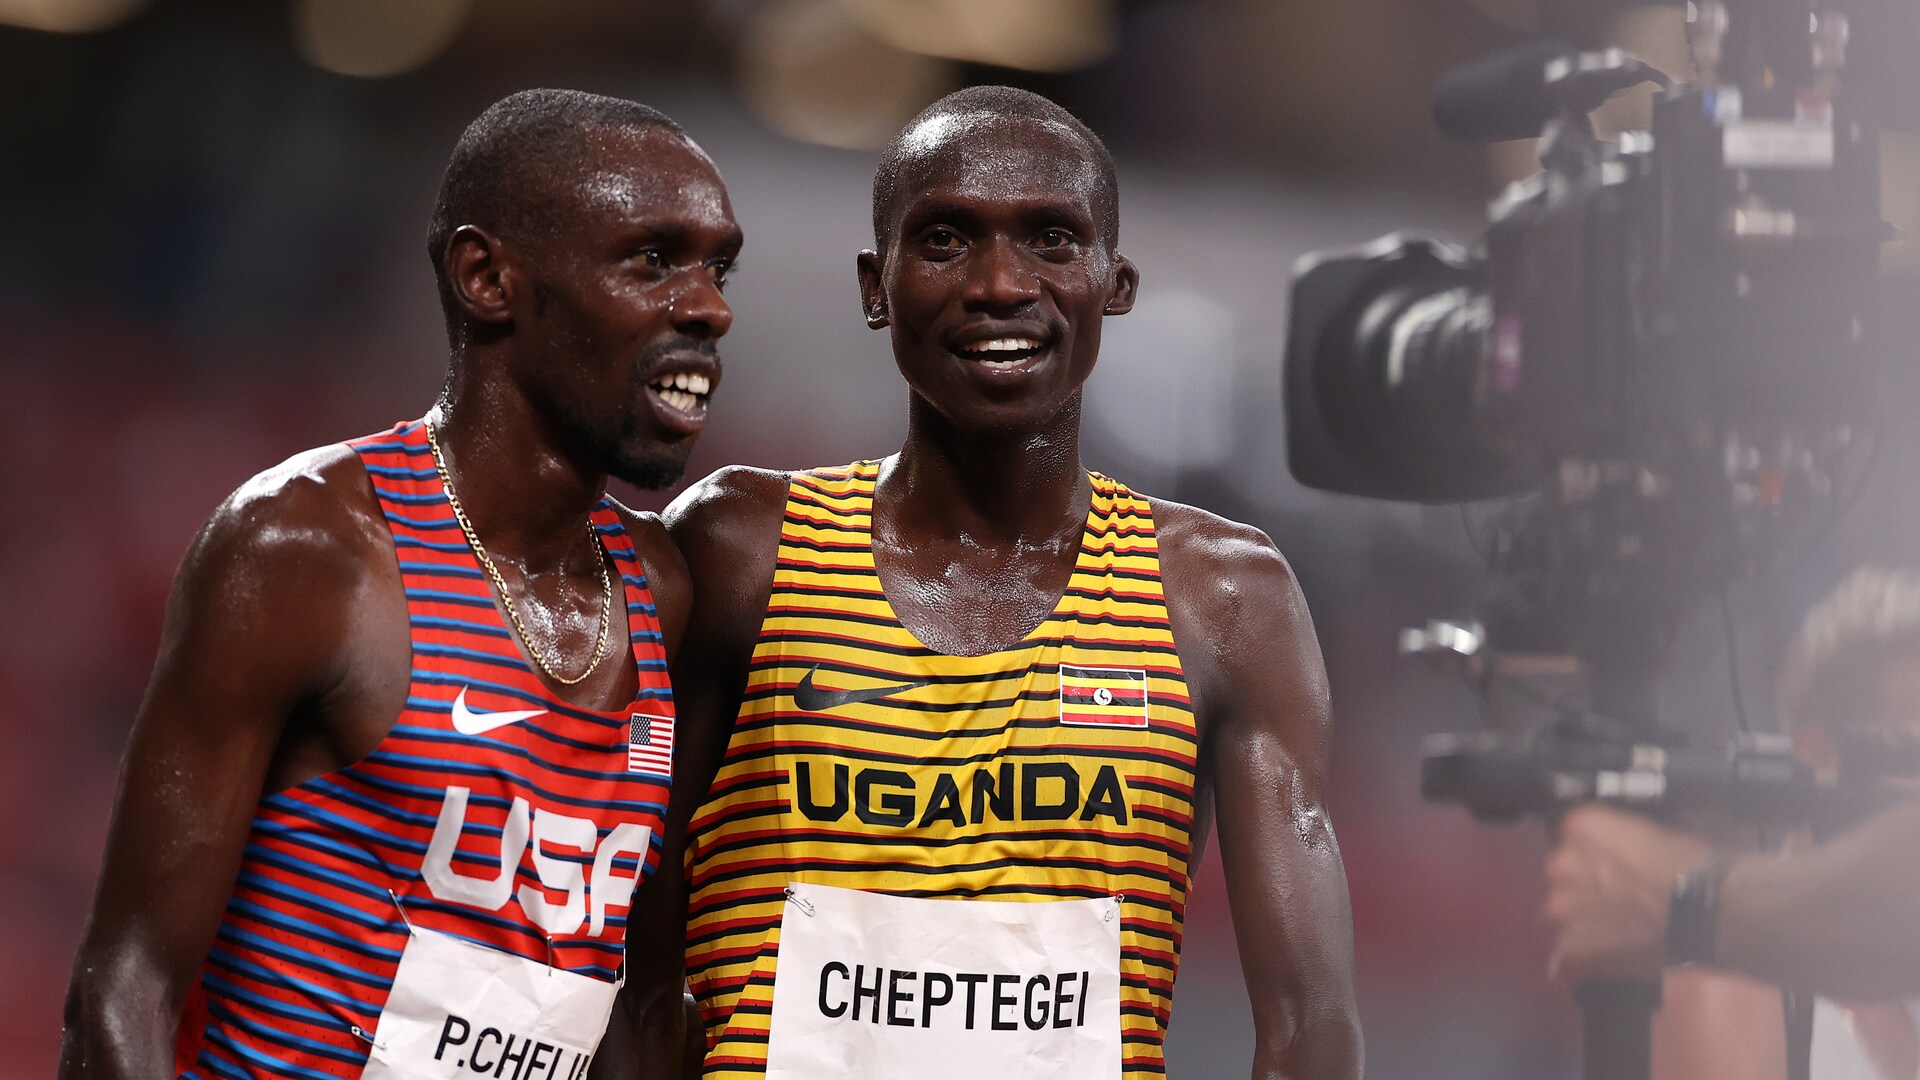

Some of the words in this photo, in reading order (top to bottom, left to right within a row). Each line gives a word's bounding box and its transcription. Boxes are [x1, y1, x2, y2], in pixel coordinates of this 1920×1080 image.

[795, 761, 1128, 828] UGANDA
[420, 785, 652, 938] USA
[818, 961, 1090, 1031] CHEPTEGEI
